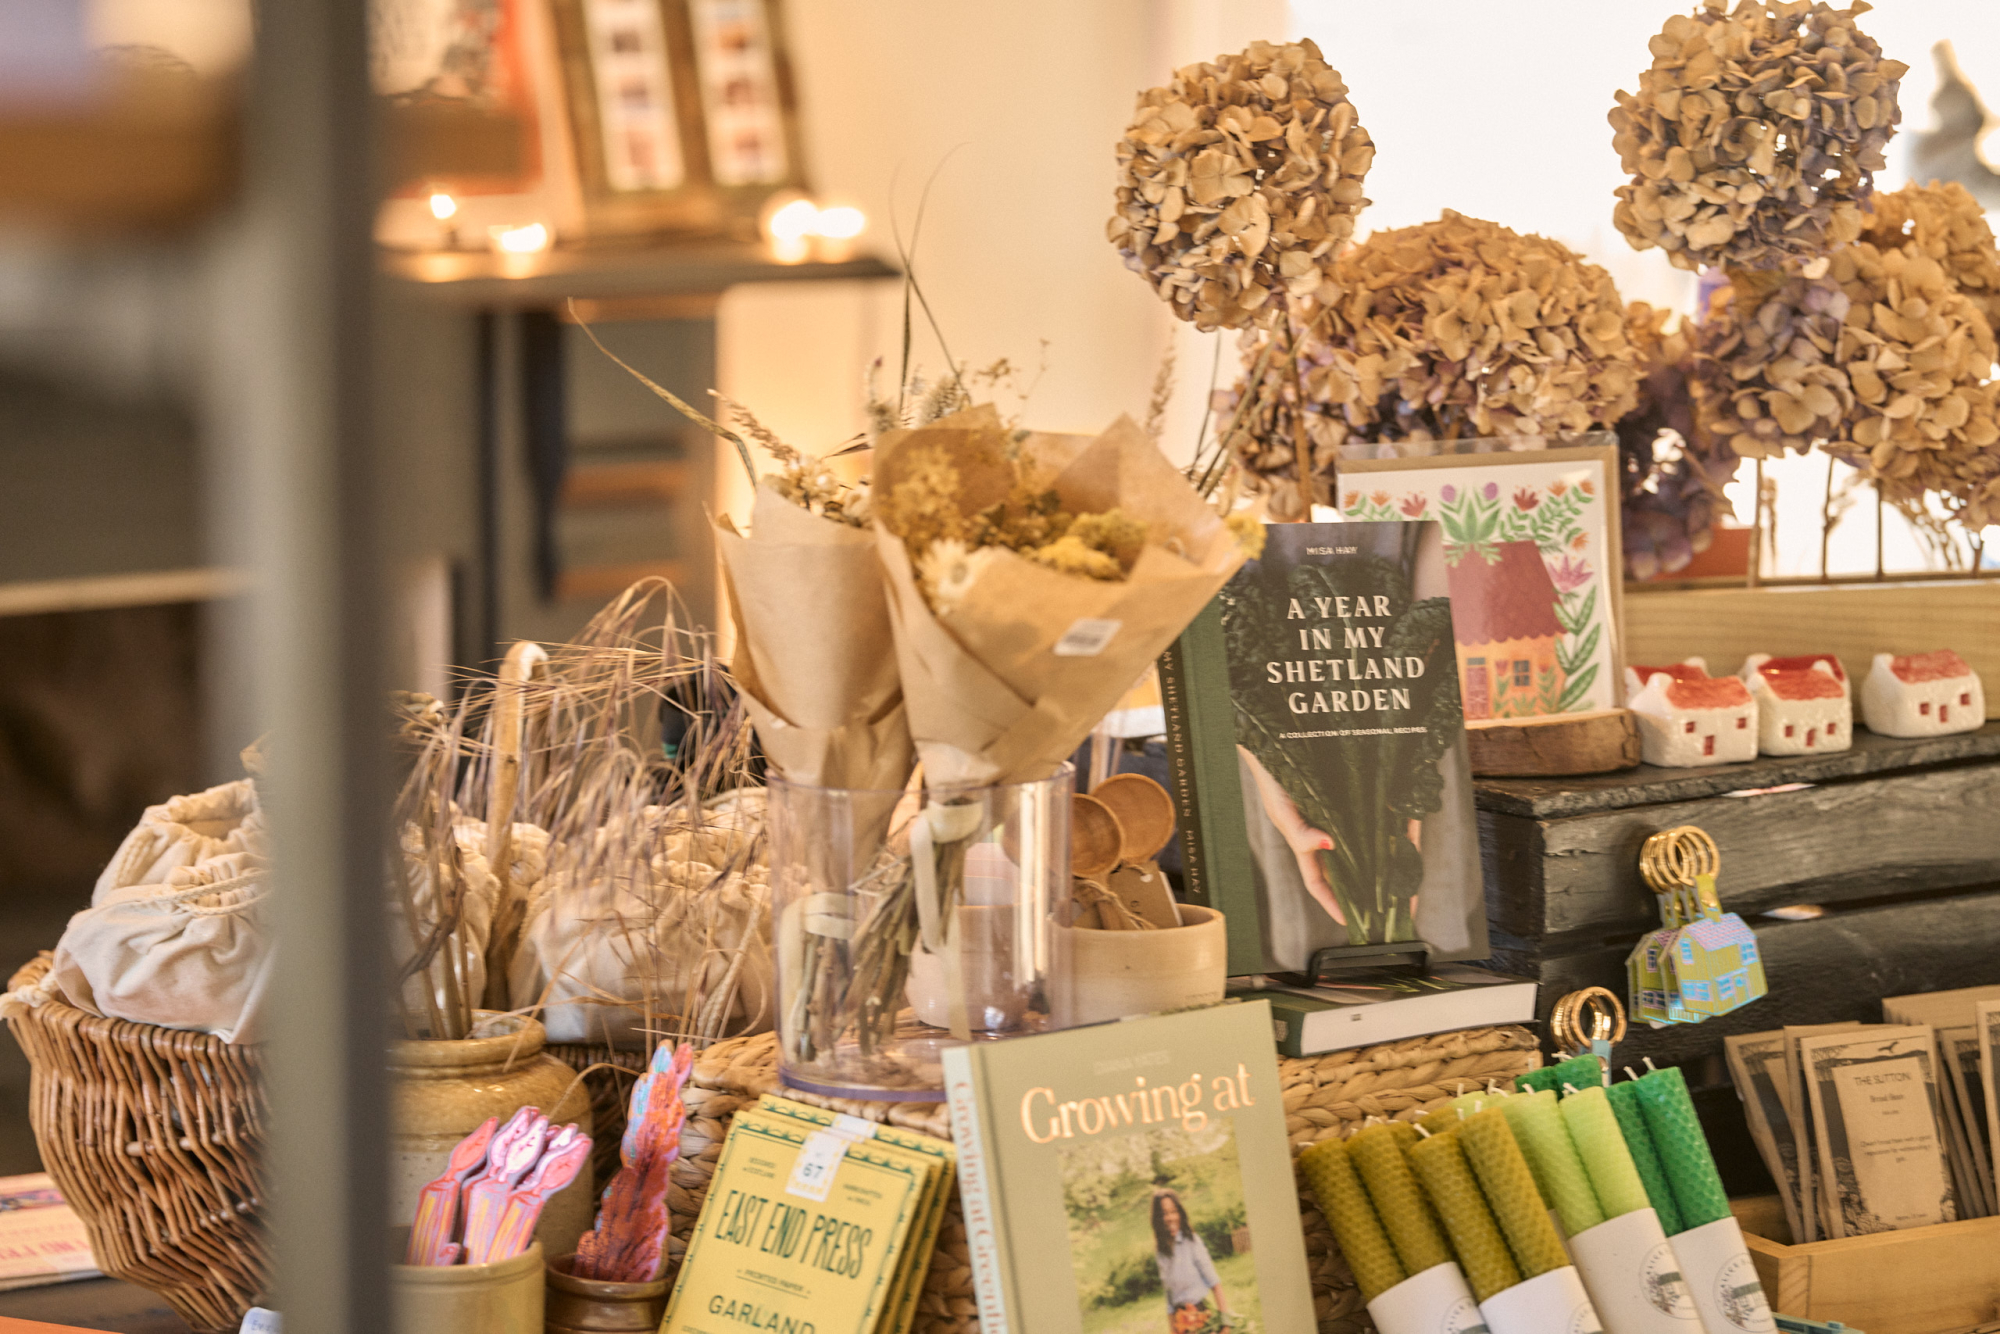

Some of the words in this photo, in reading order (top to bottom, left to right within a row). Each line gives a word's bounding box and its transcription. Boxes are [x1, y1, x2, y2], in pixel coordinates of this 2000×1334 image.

[1306, 547, 1334, 556] MISA
[1287, 598, 1306, 620] A
[1314, 595, 1392, 619] YEAR
[1299, 628, 1332, 651] IN
[1344, 626, 1385, 649] MY
[1162, 650, 1174, 671] MY
[1266, 656, 1425, 684] SHETLAND
[1288, 688, 1411, 714] GARDEN
[1165, 677, 1183, 753] SHETLAND
[1287, 730, 1339, 739] COLLECTION
[1351, 728, 1393, 736] SEASONAL
[1176, 757, 1192, 817] GARDEN
[1185, 830, 1197, 864] MISA
[1853, 1076, 1872, 1086] THE
[1873, 1072, 1912, 1083] SUTTON
[1020, 1073, 1208, 1144] Growing
[1211, 1063, 1256, 1111] at
[715, 1189, 769, 1247] EAST
[761, 1202, 806, 1258] END
[800, 1214, 872, 1279] PRESS
[708, 1294, 815, 1334] GARLAND
